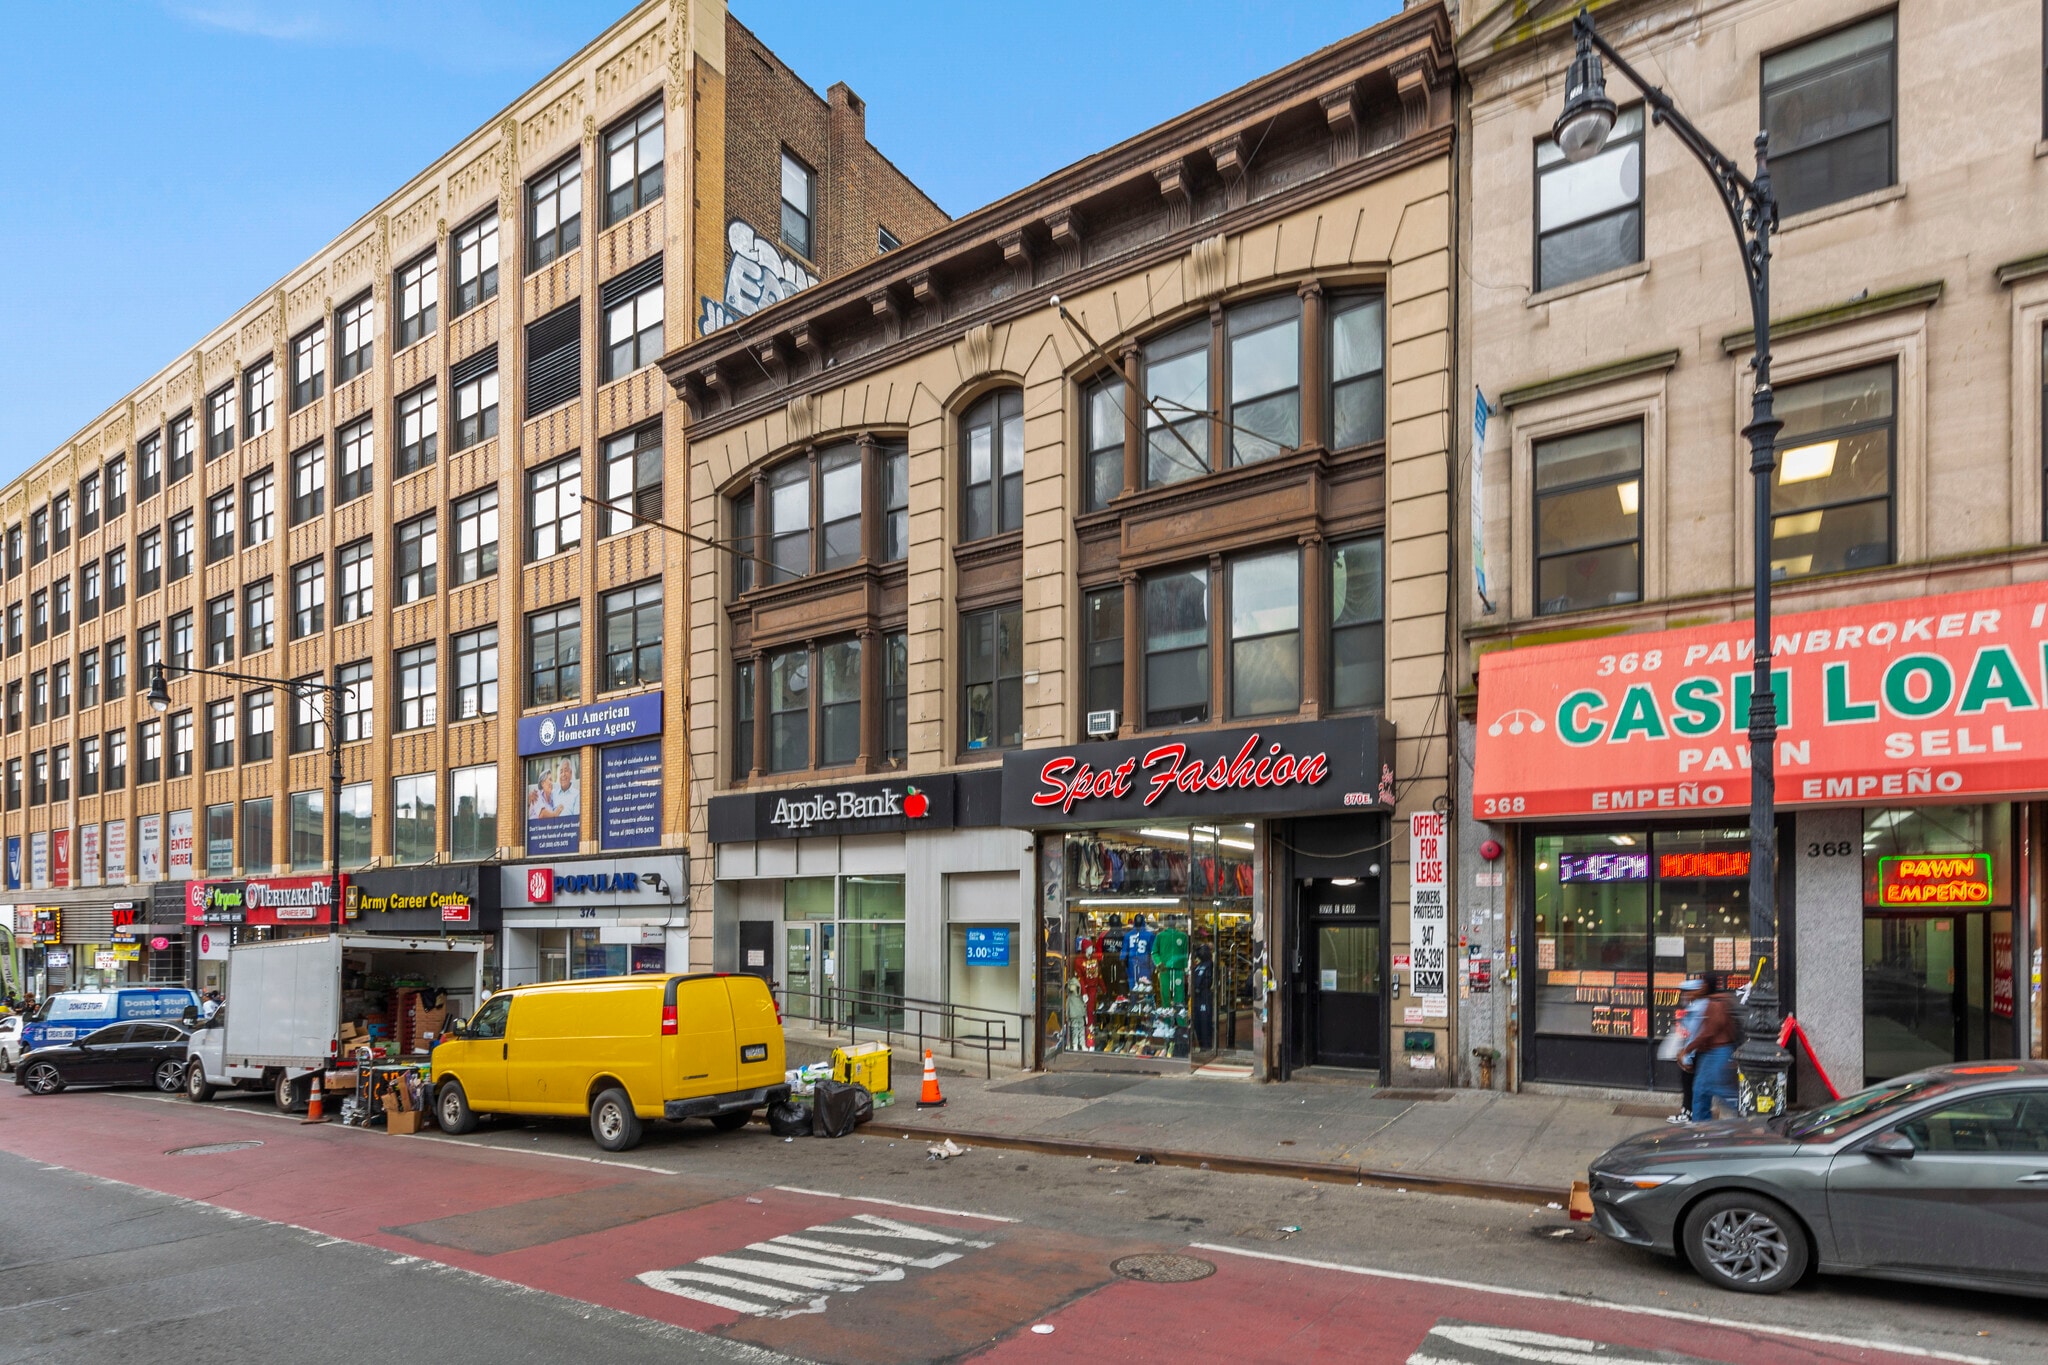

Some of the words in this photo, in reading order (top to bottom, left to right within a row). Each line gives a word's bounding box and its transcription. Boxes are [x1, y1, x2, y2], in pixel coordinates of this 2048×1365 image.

[1597, 650, 1662, 676] 368
[564, 713, 578, 728] All
[581, 706, 630, 725] American
[1556, 667, 1792, 747] CASH
[558, 726, 600, 742] Homecare
[603, 720, 637, 737] Agency
[1885, 725, 2022, 759] SELL
[1032, 756, 1136, 814] Spot
[1142, 733, 1328, 807] Fashion
[1803, 768, 1962, 799] EMPEÑO
[771, 794, 837, 829] Apple
[836, 788, 903, 819] Bank
[1484, 797, 1526, 815] 368
[1592, 782, 1724, 810] EMPEÑO
[1413, 814, 1444, 837] OFFICE
[171, 837, 192, 851] ENTER
[1420, 838, 1438, 860] FOR
[1808, 841, 1851, 858] 368
[171, 853, 189, 866] HERE
[1900, 859, 1974, 878] PAWN
[554, 872, 639, 894] POPULAR
[1416, 861, 1443, 883] LEASE
[214, 888, 243, 911] Organic
[259, 884, 312, 907] TERIYAKI
[360, 895, 388, 913] Army
[390, 892, 427, 910] Career
[430, 891, 469, 908] Center
[1416, 891, 1441, 904] BROKERS
[1887, 880, 1988, 902] EMPEÑO
[111, 909, 135, 926] TAX
[580, 907, 596, 918] 374
[1413, 905, 1444, 919] PROTECTED
[1422, 926, 1434, 945] 347
[1414, 948, 1444, 969] 926-3391
[1415, 971, 1442, 986] RW
[124, 999, 162, 1007] Donate
[163, 997, 188, 1006] Stuff
[128, 1009, 162, 1017] Create
